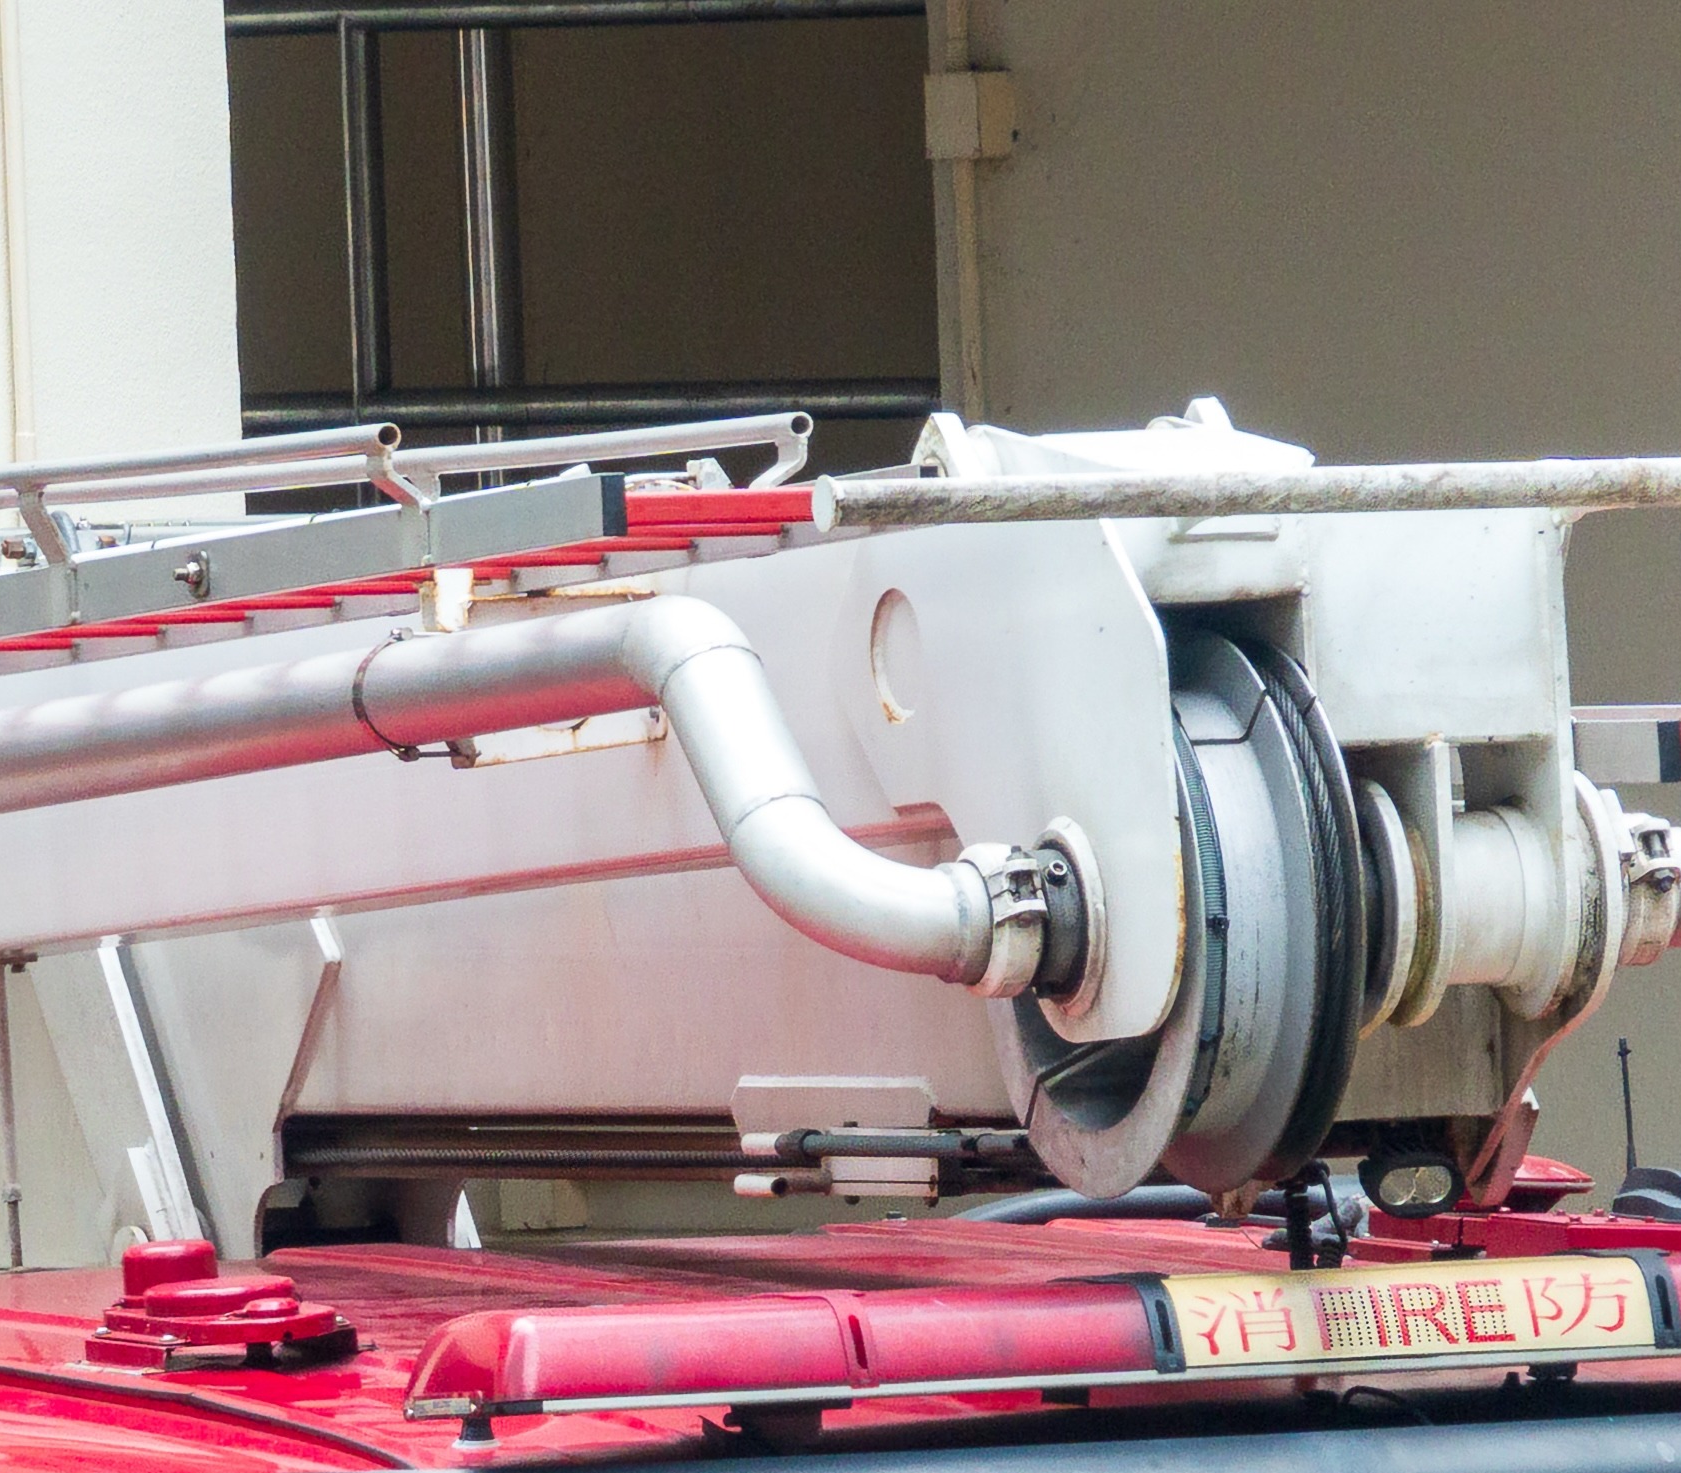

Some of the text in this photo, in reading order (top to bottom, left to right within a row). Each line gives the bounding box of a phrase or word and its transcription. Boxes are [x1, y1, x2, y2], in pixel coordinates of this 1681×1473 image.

[1189, 1274, 1634, 1356] 消 FIRE 防
